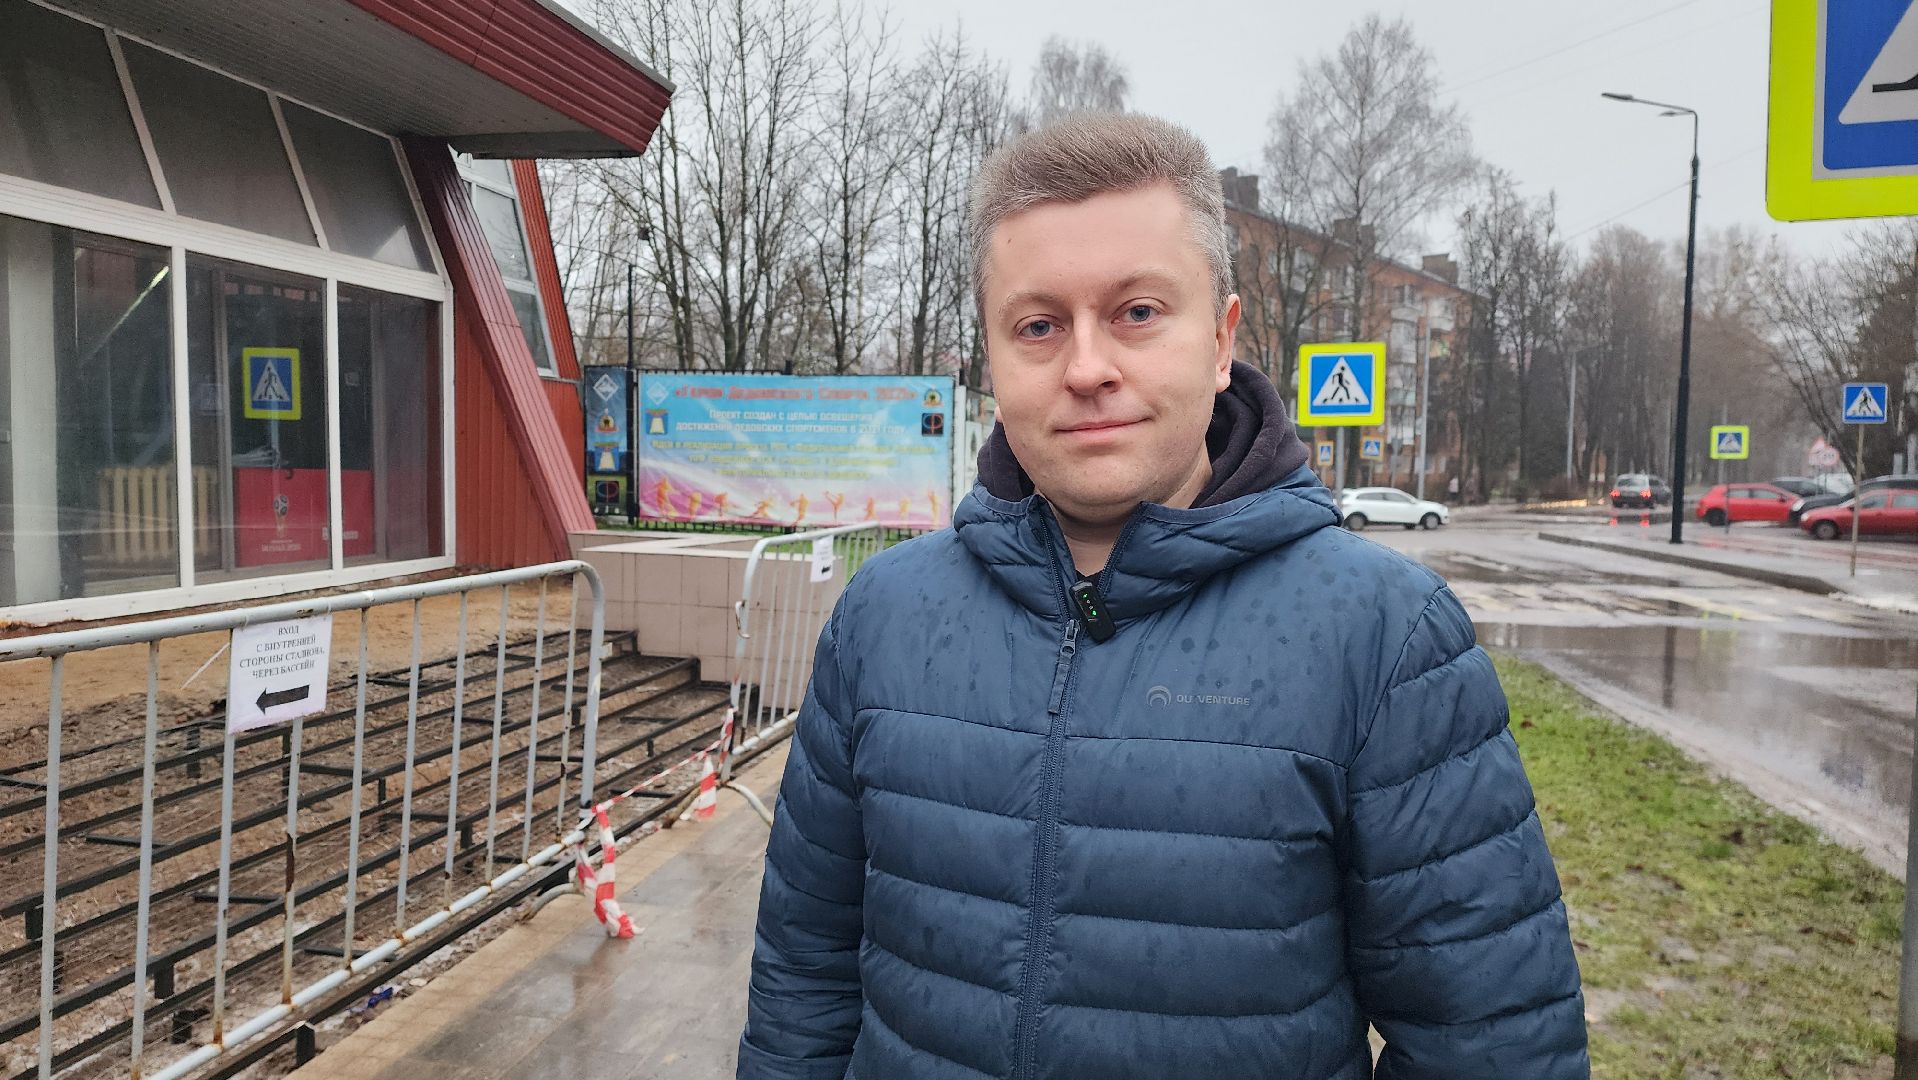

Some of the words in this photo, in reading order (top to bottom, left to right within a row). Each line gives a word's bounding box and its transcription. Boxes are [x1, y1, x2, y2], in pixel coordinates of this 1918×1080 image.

[278, 625, 299, 636] ВХОД
[256, 643, 263, 653] С
[264, 634, 316, 651] ВНУТРЕННЕЙ
[239, 653, 283, 669] СТОРОНЫ
[252, 667, 279, 679] ЧЕРЕЗ
[280, 659, 315, 674] БАССЕЙН
